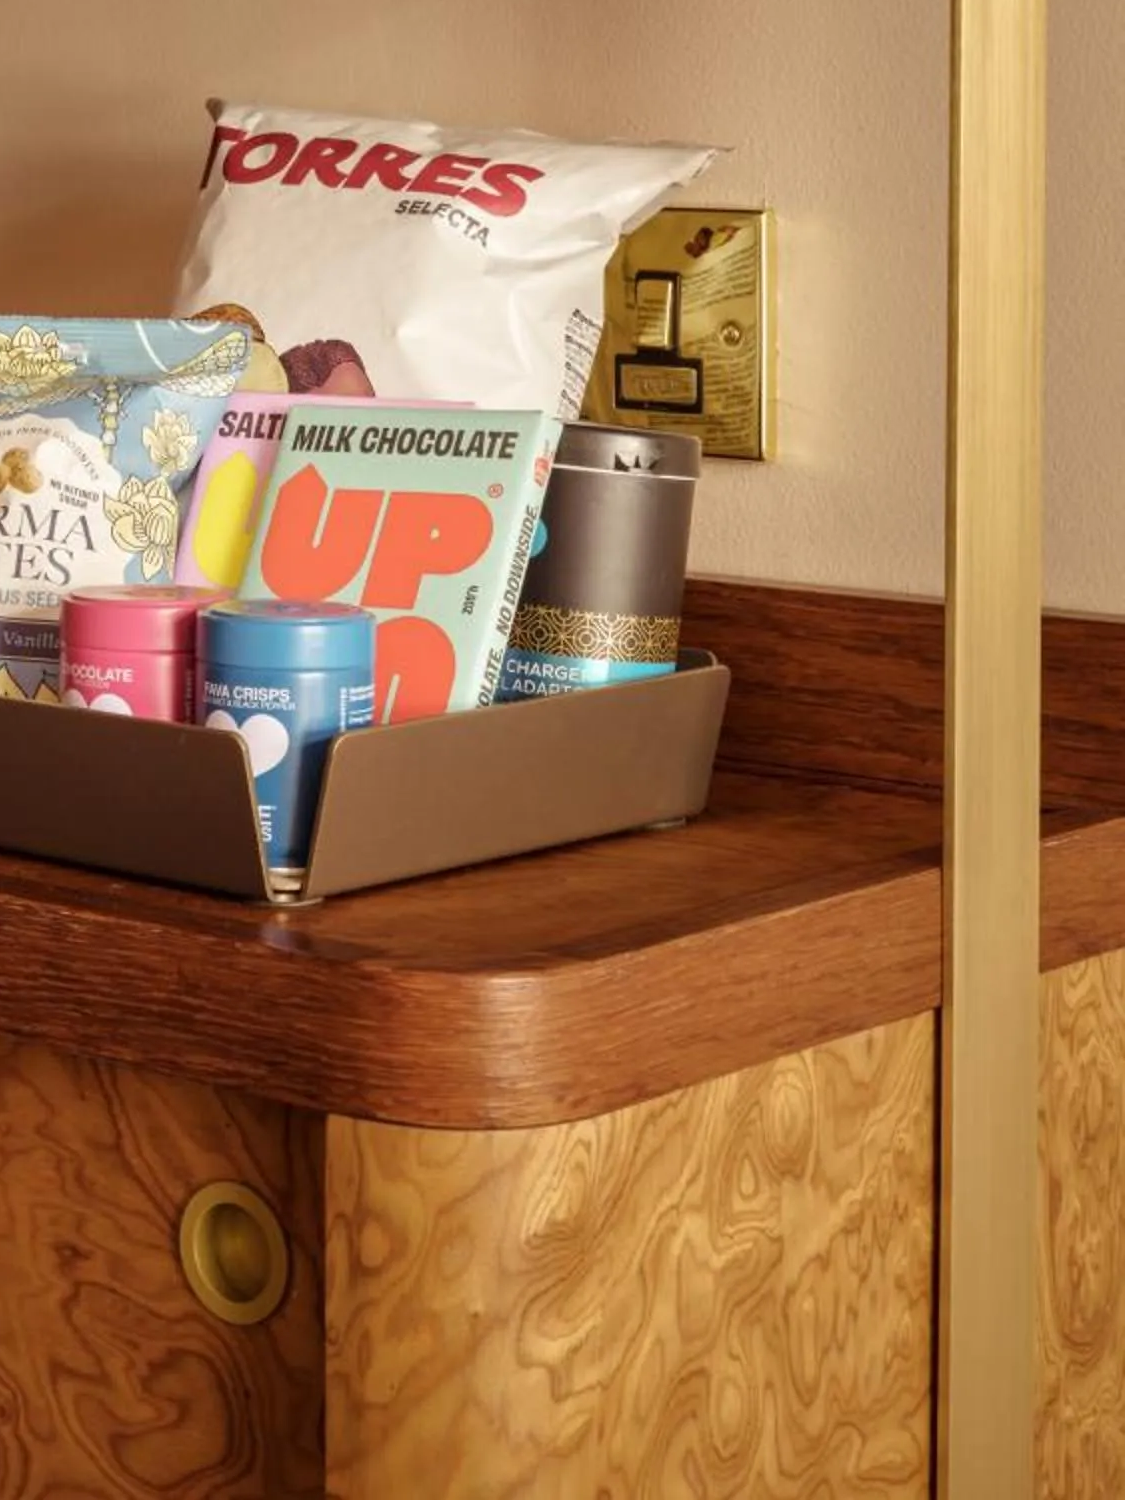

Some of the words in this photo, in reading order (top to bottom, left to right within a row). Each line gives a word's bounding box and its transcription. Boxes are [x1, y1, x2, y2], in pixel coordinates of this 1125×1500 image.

[201, 125, 546, 217] TORRES
[394, 199, 492, 248] SELECTA
[292, 425, 357, 453] MILK
[359, 427, 519, 460] CHOCOLATE
[260, 462, 494, 610] UP
[25, 590, 62, 608] SEE
[476, 647, 505, 709] OLATE.
[496, 607, 513, 636] NO
[506, 659, 587, 683] CHARGE
[203, 681, 231, 698] FAVA
[232, 686, 290, 703] CRISPS
[511, 679, 582, 697] ADAPT
